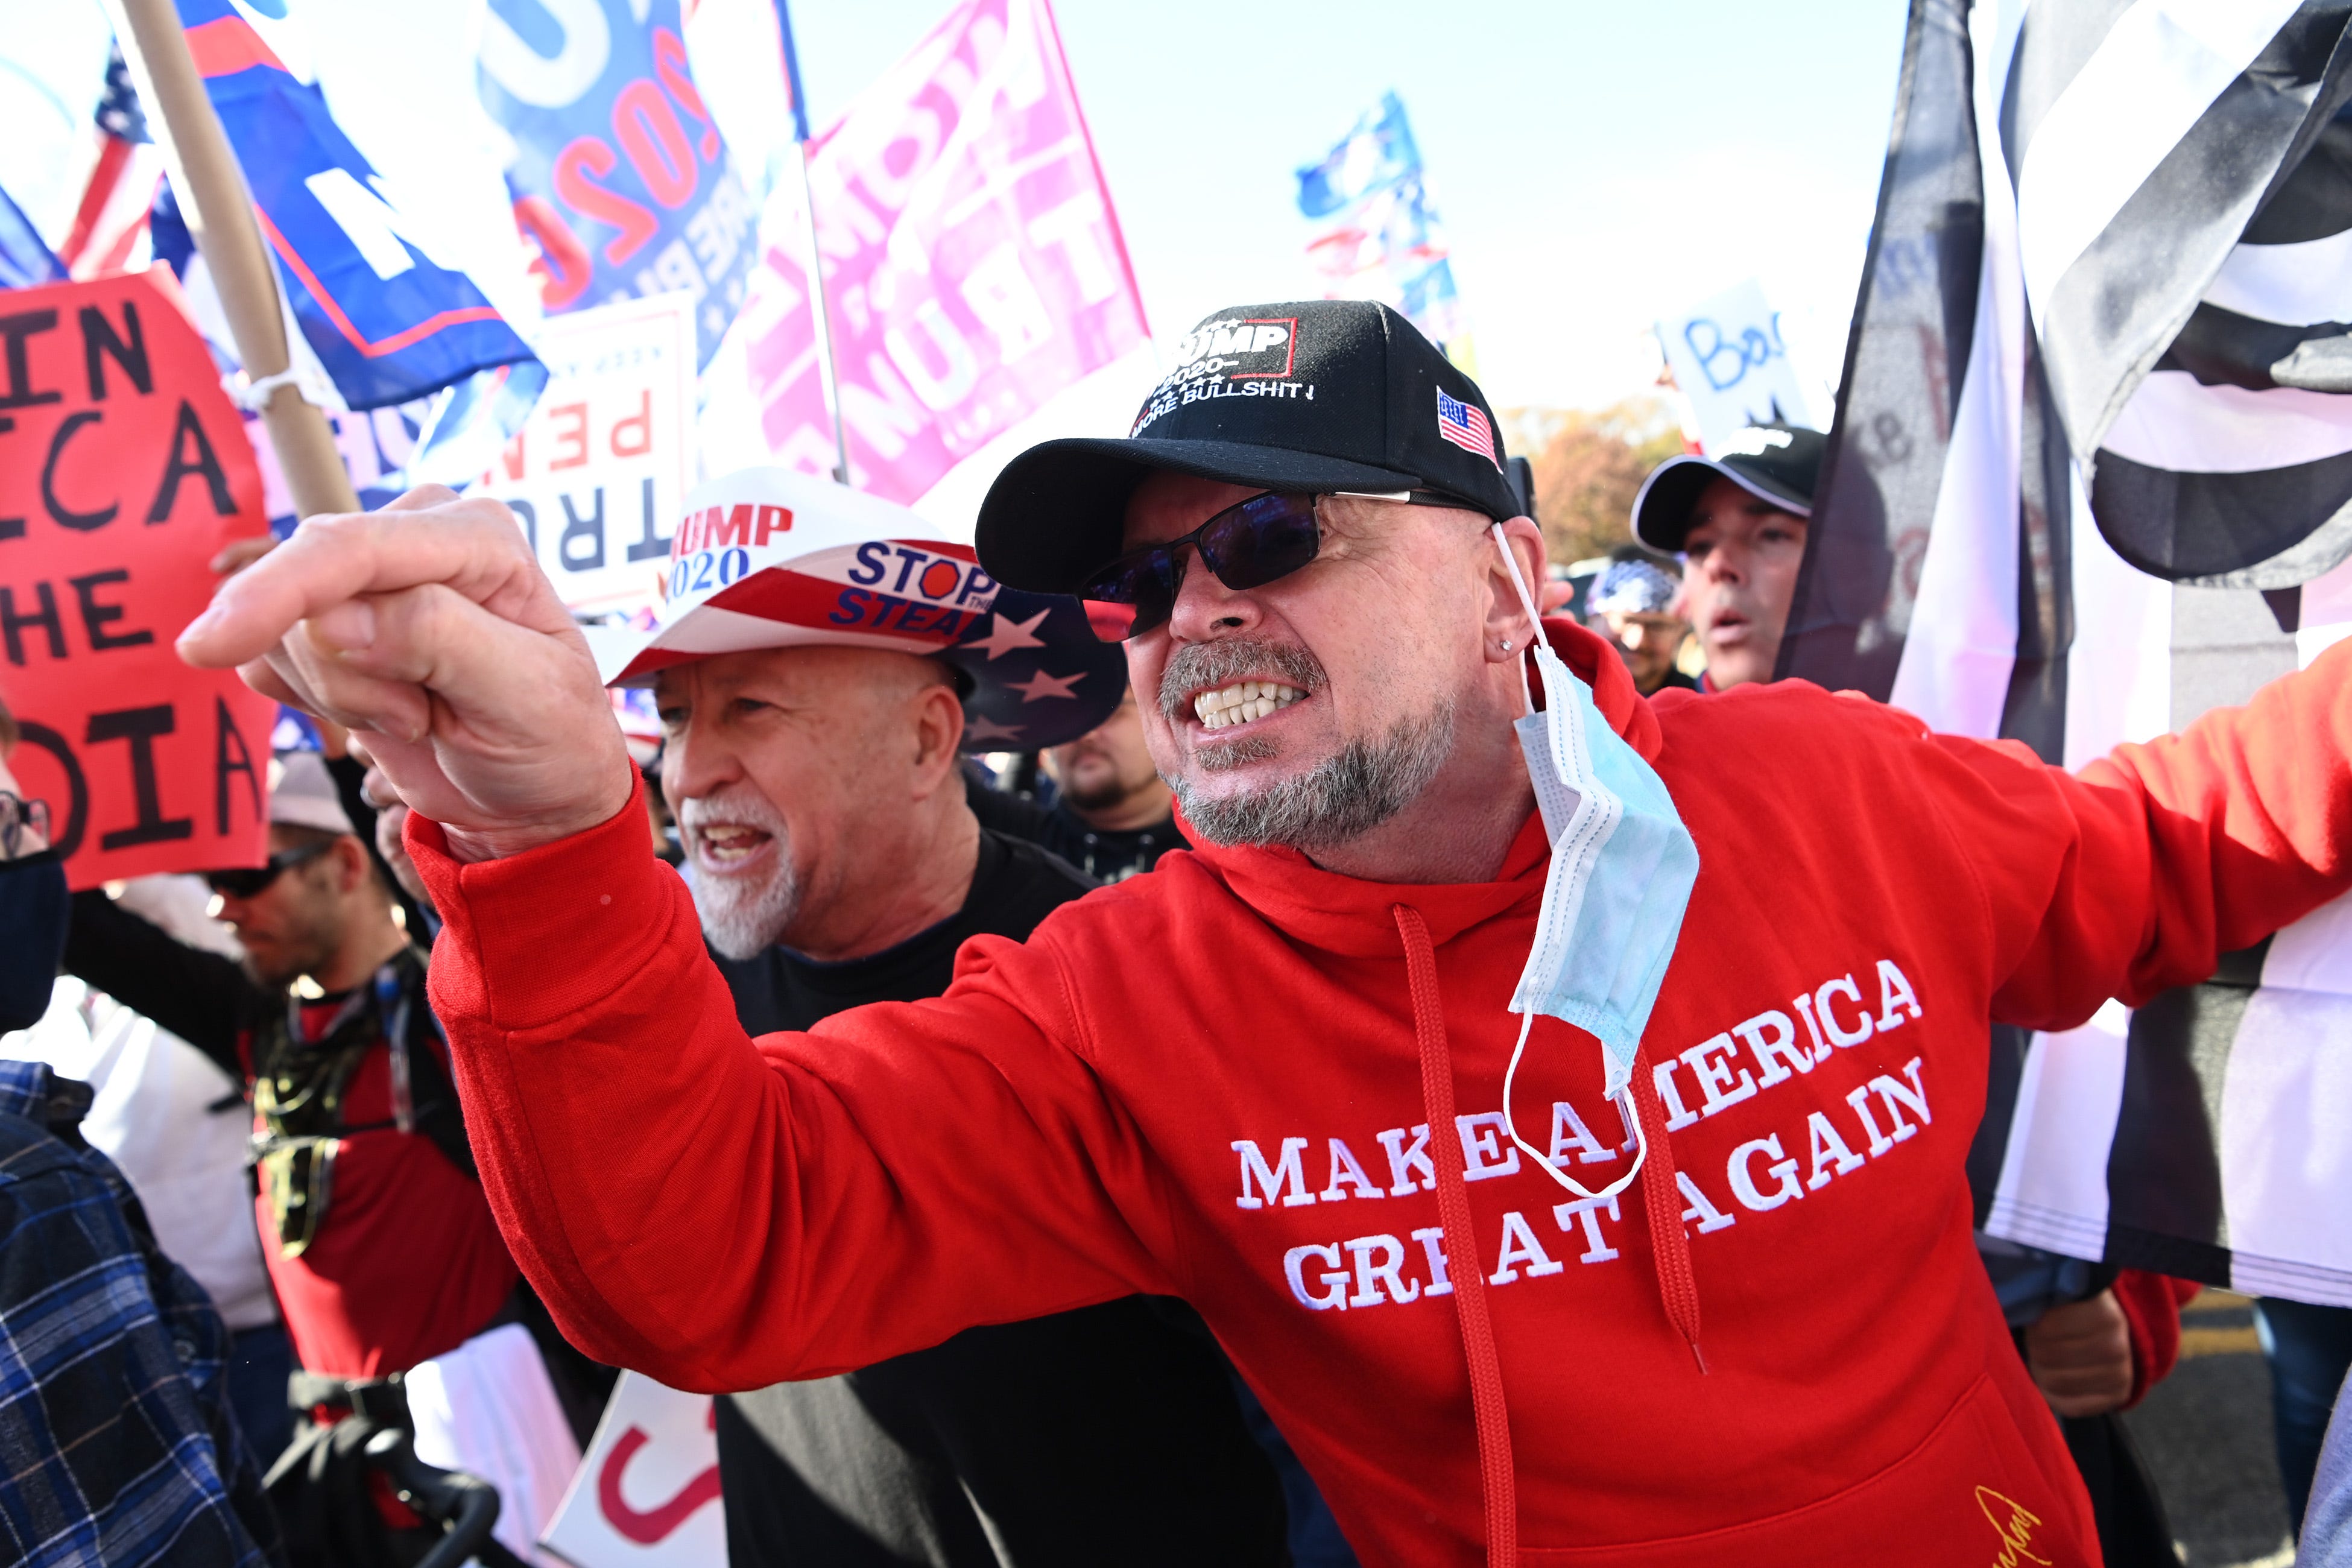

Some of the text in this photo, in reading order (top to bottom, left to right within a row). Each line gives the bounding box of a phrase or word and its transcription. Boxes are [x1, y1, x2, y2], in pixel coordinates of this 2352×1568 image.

[1131, 396, 1178, 439] MORE
[671, 503, 794, 563] UMP
[666, 548, 750, 604] 020
[848, 541, 996, 604] STOP
[829, 587, 964, 636] STEA
[1230, 959, 1923, 1209] MAKE AMERICA
[1675, 1055, 1932, 1240] AGAIN
